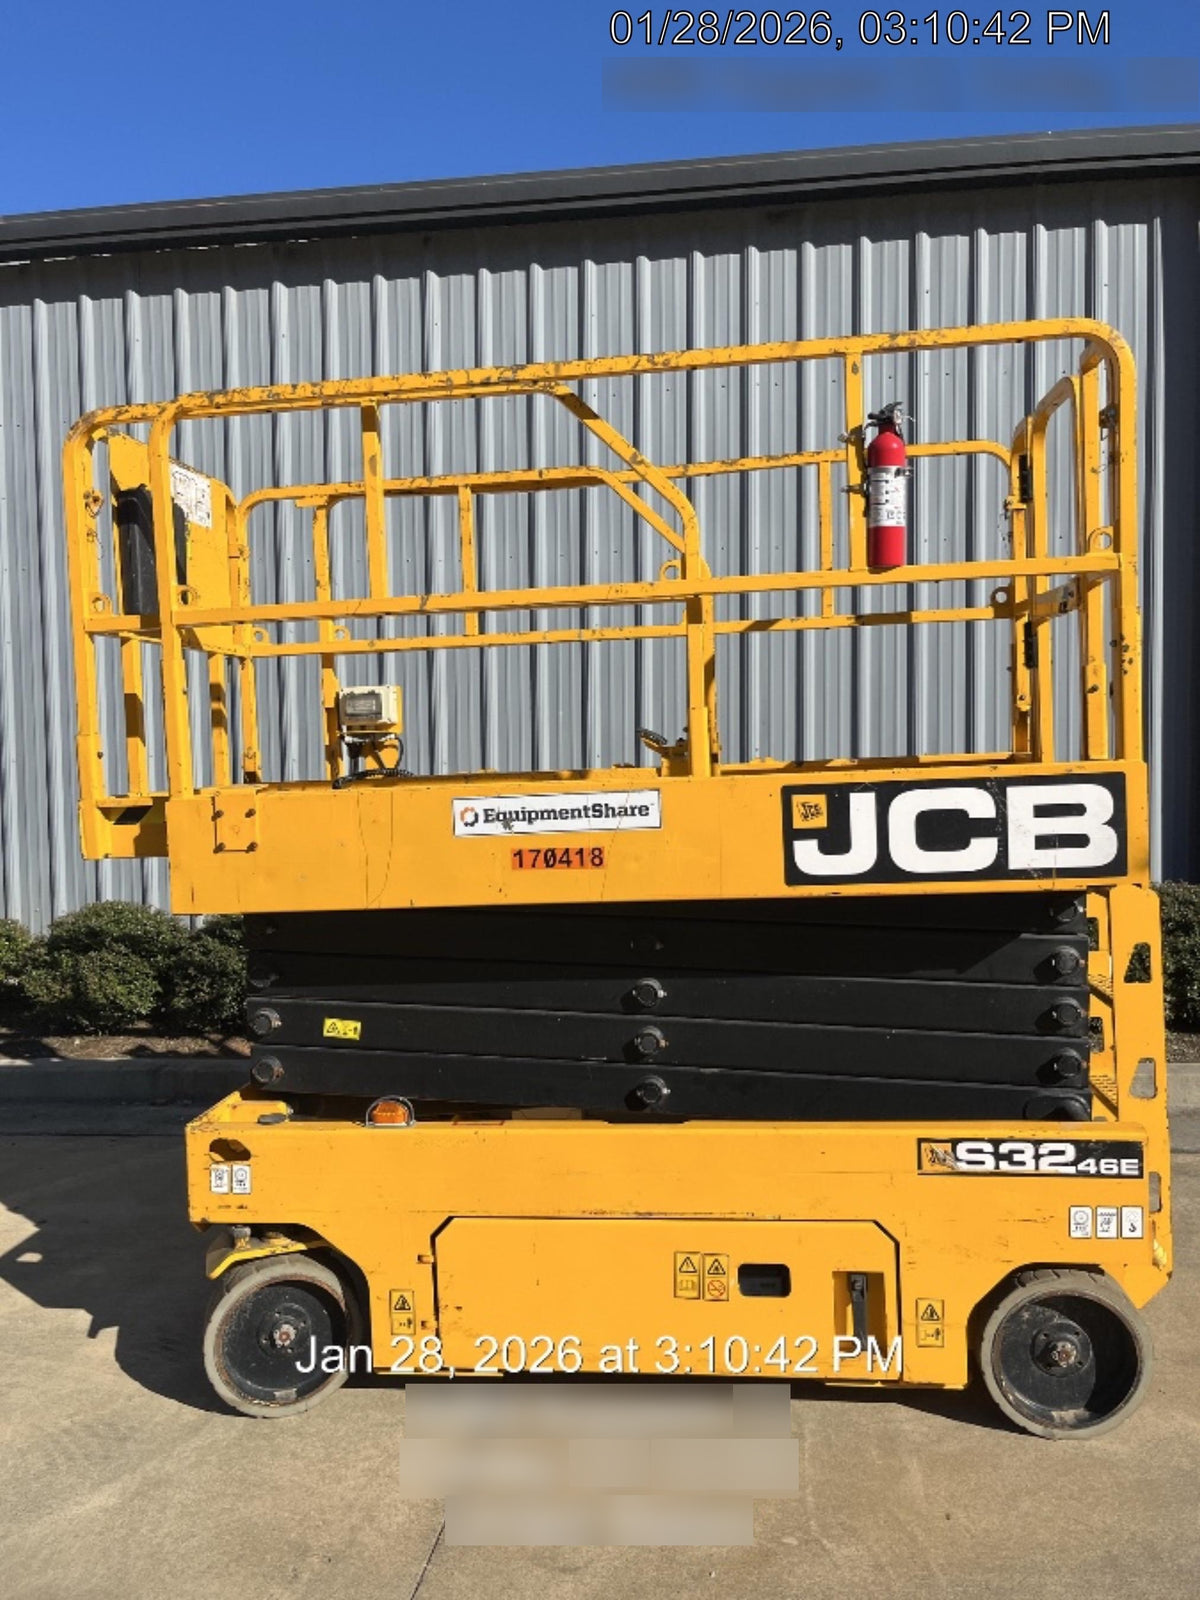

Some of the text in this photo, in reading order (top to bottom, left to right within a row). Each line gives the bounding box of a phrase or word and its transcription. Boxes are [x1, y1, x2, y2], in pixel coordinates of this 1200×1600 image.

[483, 803, 650, 827] EquipmentShare
[793, 783, 1118, 876] JCB
[512, 847, 604, 869] 170418
